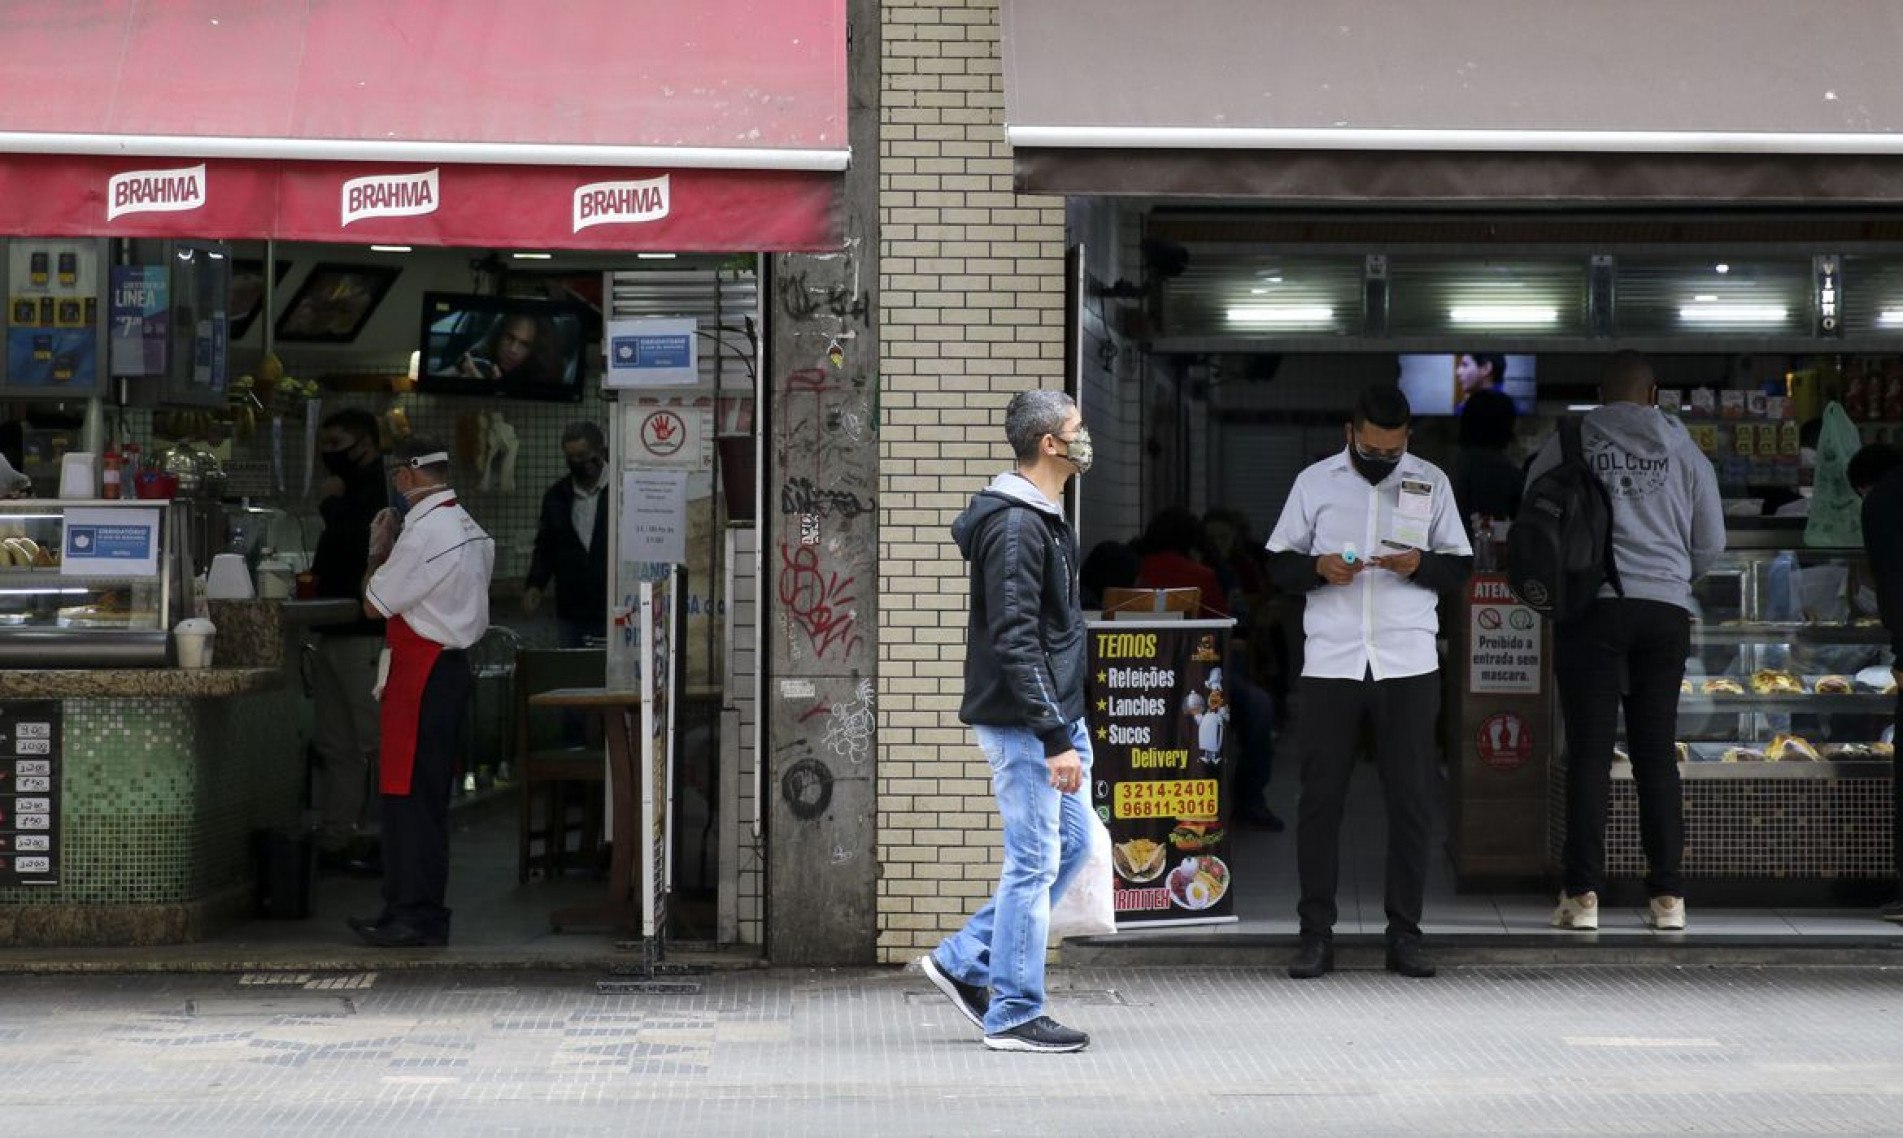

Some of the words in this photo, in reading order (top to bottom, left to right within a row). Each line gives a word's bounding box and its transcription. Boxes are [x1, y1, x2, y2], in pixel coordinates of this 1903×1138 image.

[115, 174, 200, 208] BRAHMA
[349, 180, 433, 213] BRAHMA
[580, 186, 664, 219] BRAHMA
[1096, 633, 1157, 658] TEMOS
[1479, 635, 1523, 650] Proibido
[1526, 639, 1533, 650] a
[1473, 652, 1514, 666] entrada
[1517, 655, 1538, 666] sem
[1108, 666, 1175, 691] Refeições
[1108, 695, 1165, 717] Lanches
[1108, 724, 1151, 744] Sucos
[1131, 747, 1188, 769] Delivery
[1123, 781, 1215, 799] 3214-2401
[1123, 799, 1216, 816] 96811-3016
